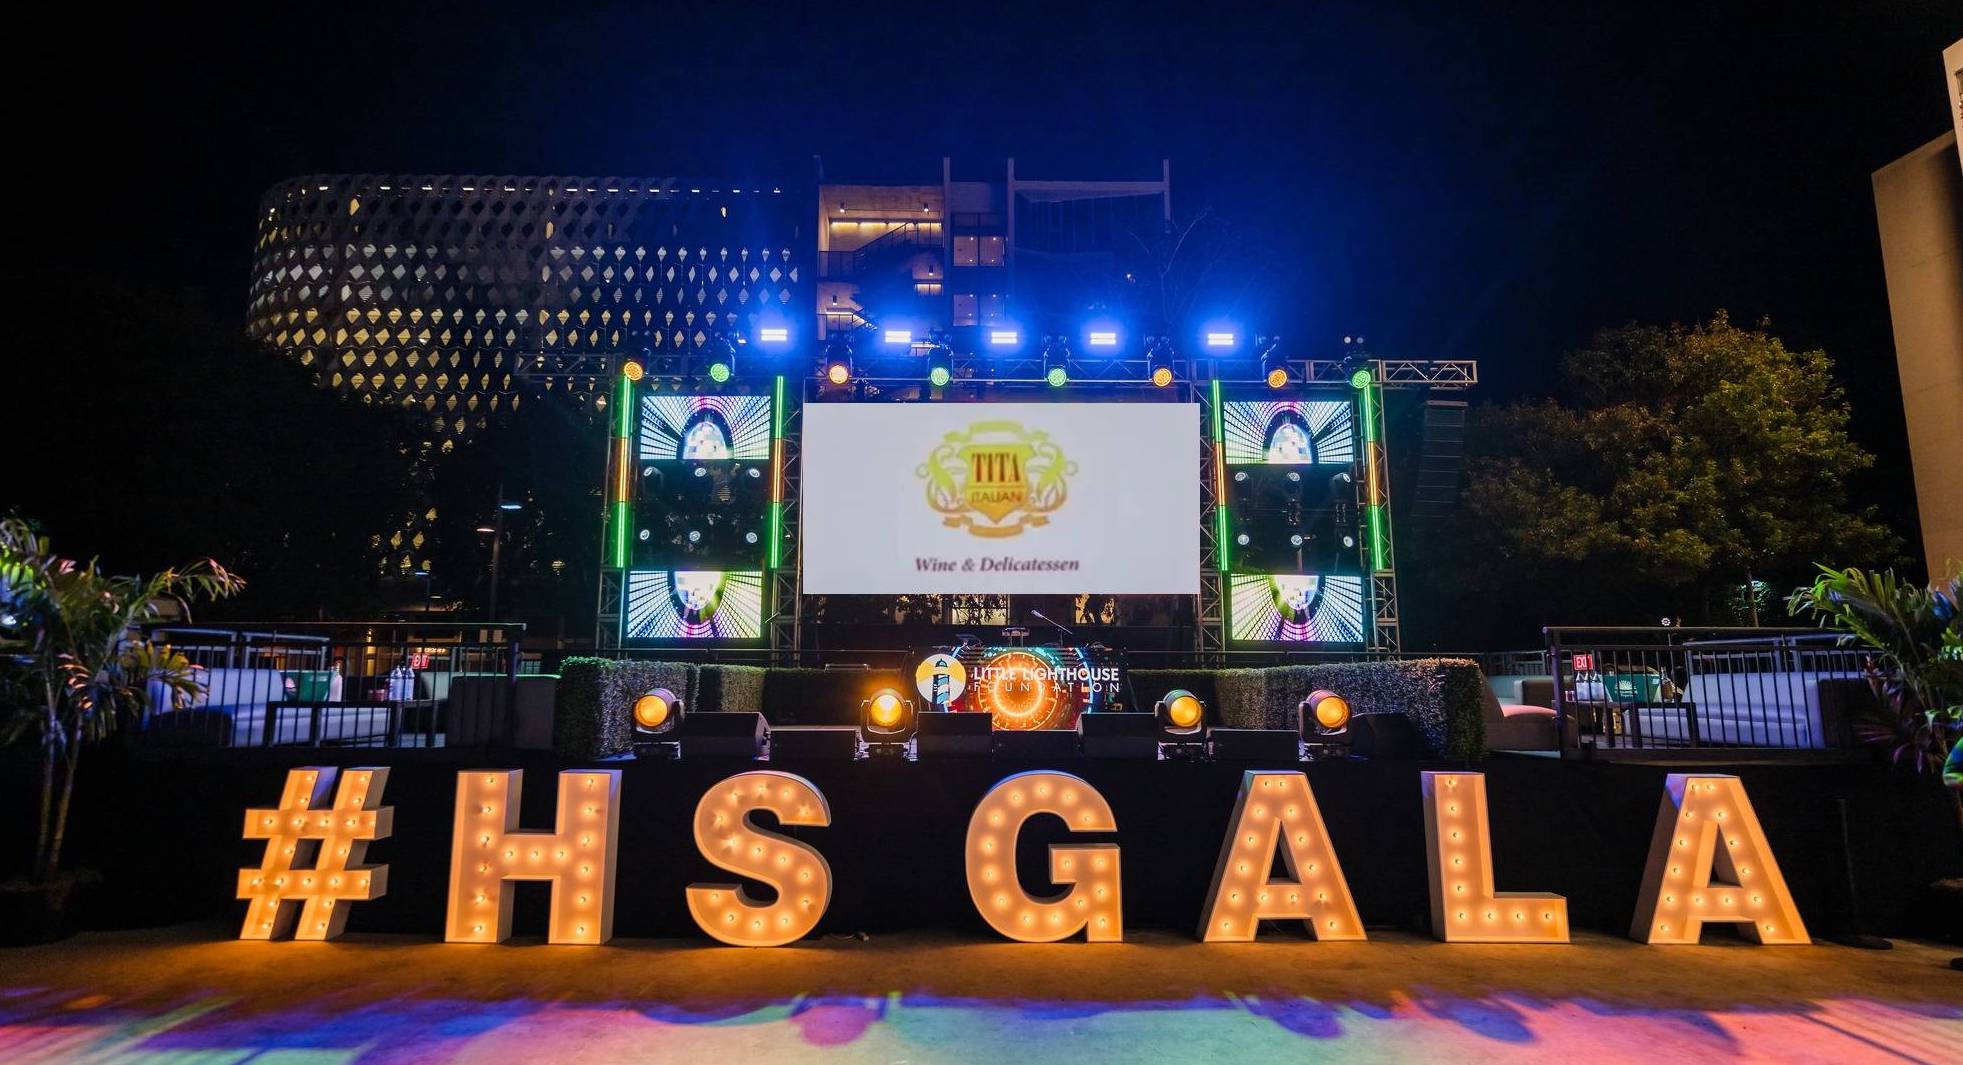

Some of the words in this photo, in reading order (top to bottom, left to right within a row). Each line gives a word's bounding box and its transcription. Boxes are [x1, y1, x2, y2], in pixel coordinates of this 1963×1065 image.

[971, 453, 1021, 483] TITA
[971, 492, 1022, 503] ITALIAN
[915, 557, 957, 572] Wine
[961, 558, 975, 572] &
[980, 556, 1080, 572] Delicatessen
[973, 668, 1018, 680] LITTLE
[1022, 668, 1119, 680] LIGHTHOUSE
[974, 682, 1120, 692] FOUNDATION
[964, 769, 1812, 944] GALA
